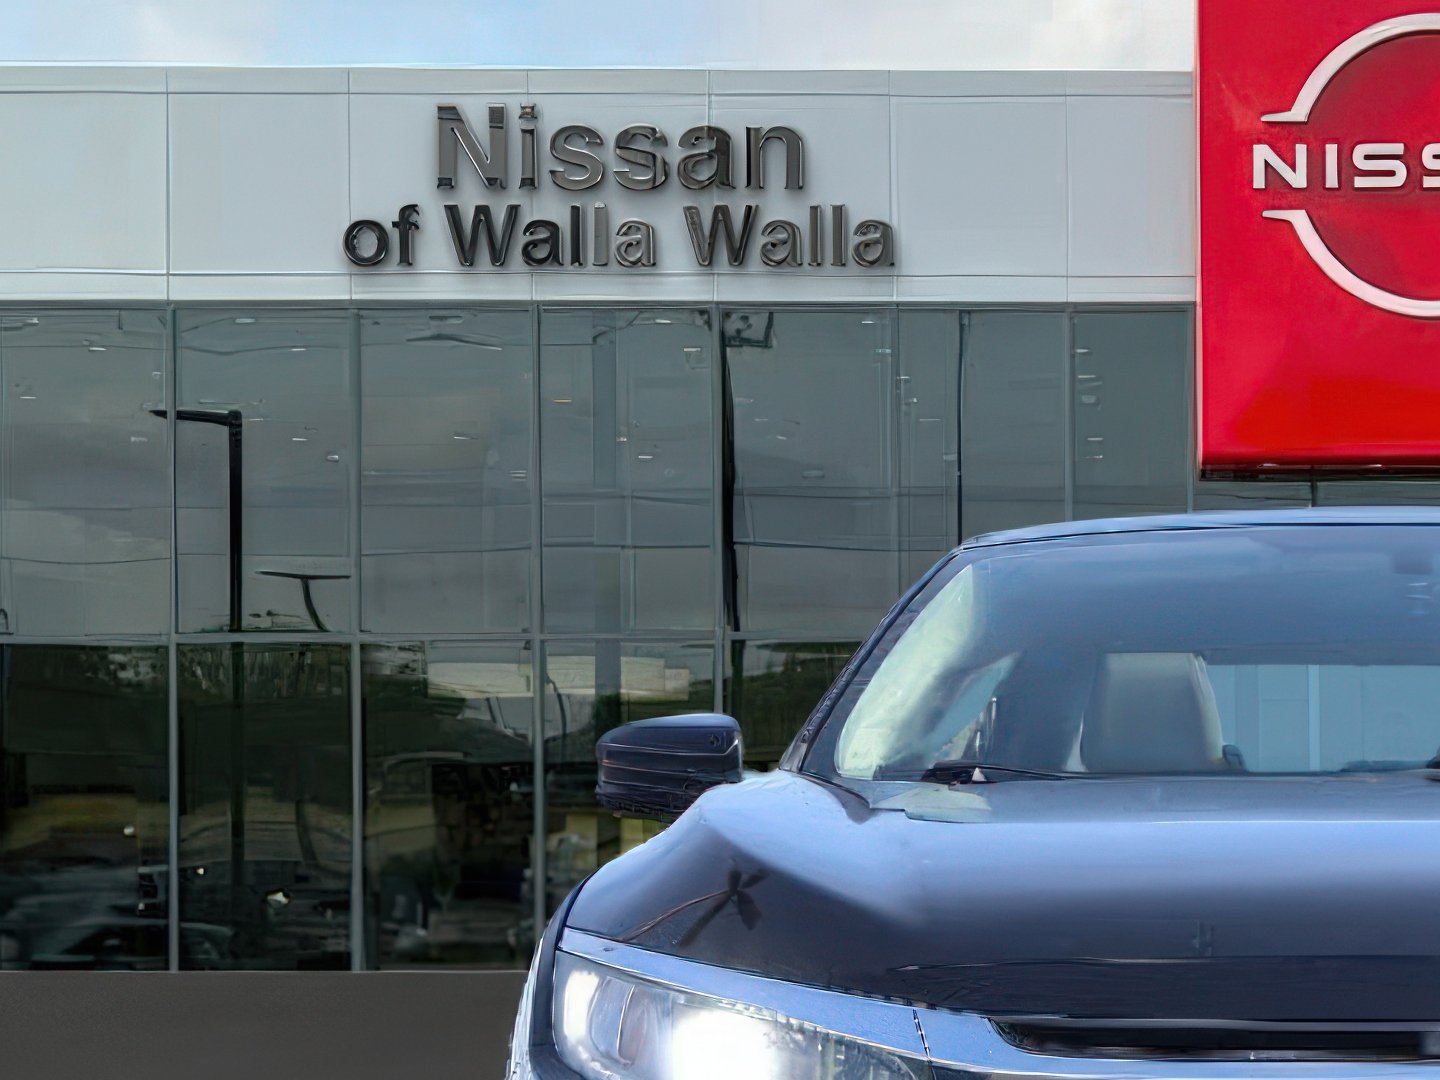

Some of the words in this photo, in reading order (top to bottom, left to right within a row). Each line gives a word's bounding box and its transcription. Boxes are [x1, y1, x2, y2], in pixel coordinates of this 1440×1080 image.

[436, 102, 807, 191] Nissan
[343, 203, 419, 267] of
[443, 203, 657, 267] Walla
[682, 203, 895, 267] Walla
